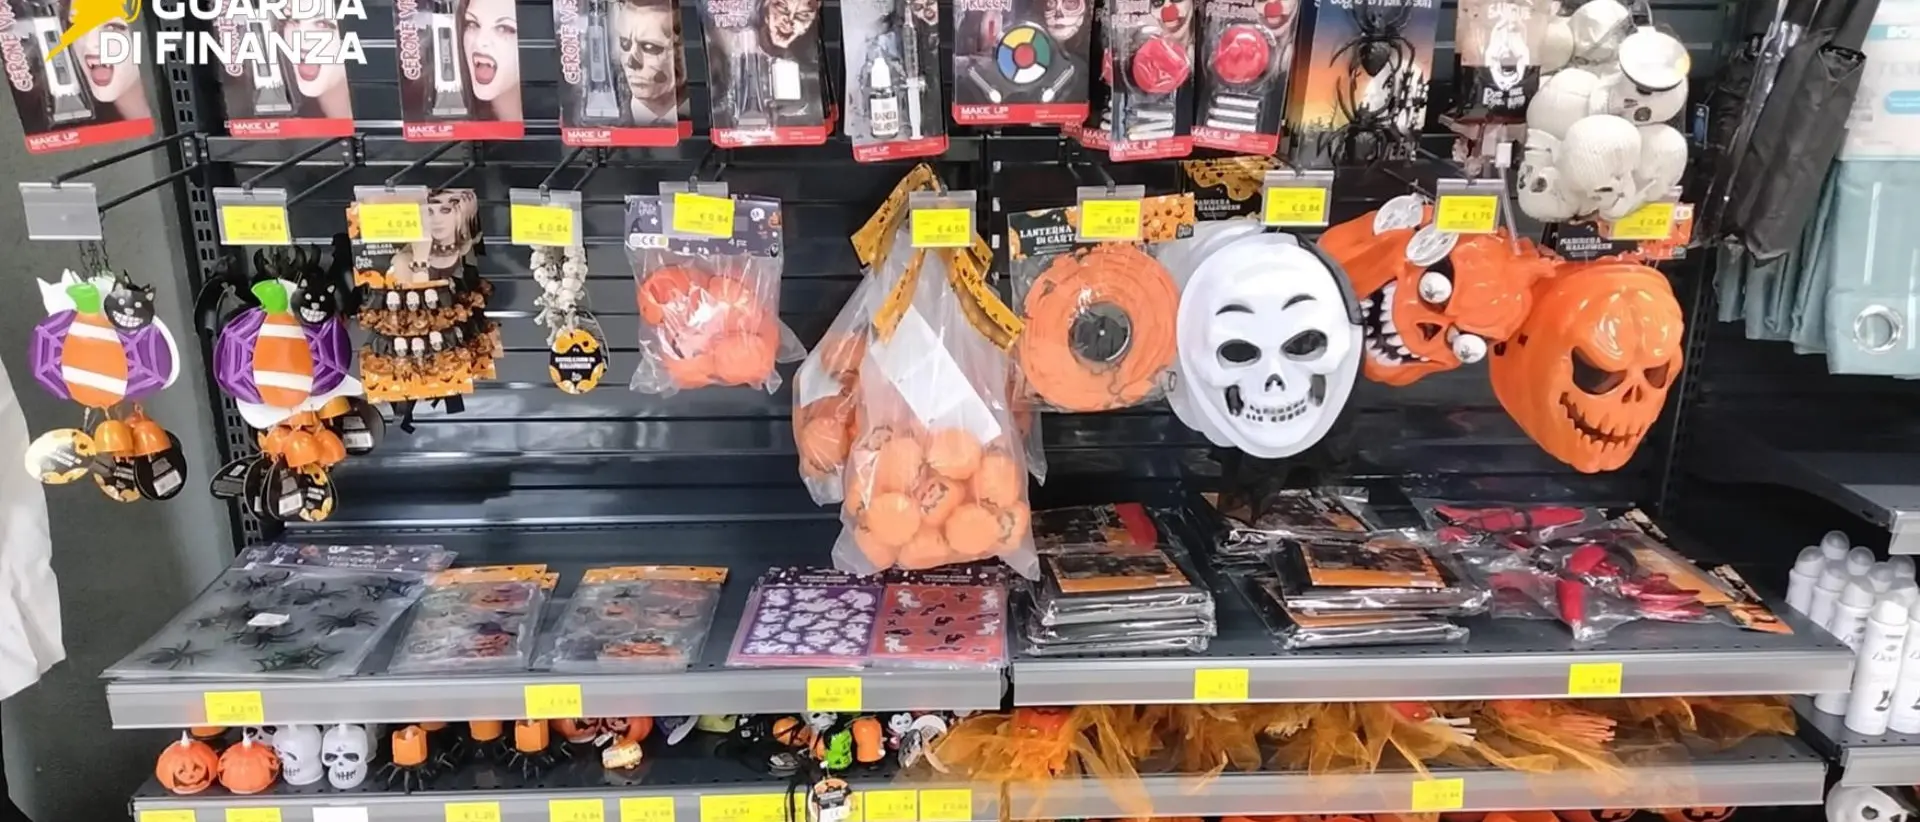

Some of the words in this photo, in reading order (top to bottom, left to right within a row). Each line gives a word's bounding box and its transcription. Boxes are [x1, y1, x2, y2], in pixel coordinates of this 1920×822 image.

[400, 20, 421, 80] CERONE
[561, 24, 581, 84] CERONE
[960, 106, 991, 115] MAKE
[994, 105, 1009, 114] UP
[232, 121, 262, 130] MAKE
[264, 121, 279, 130] UP
[407, 125, 436, 133] MAKE
[30, 133, 60, 147] MAKE
[62, 131, 79, 142] UP
[567, 130, 595, 139] MAKE
[597, 130, 611, 138] UP
[1224, 132, 1241, 141] UP
[1113, 142, 1140, 152] MAKE
[1142, 141, 1157, 150] UP
[1020, 224, 1073, 239] LANTERNA
[1036, 236, 1046, 245] DI
